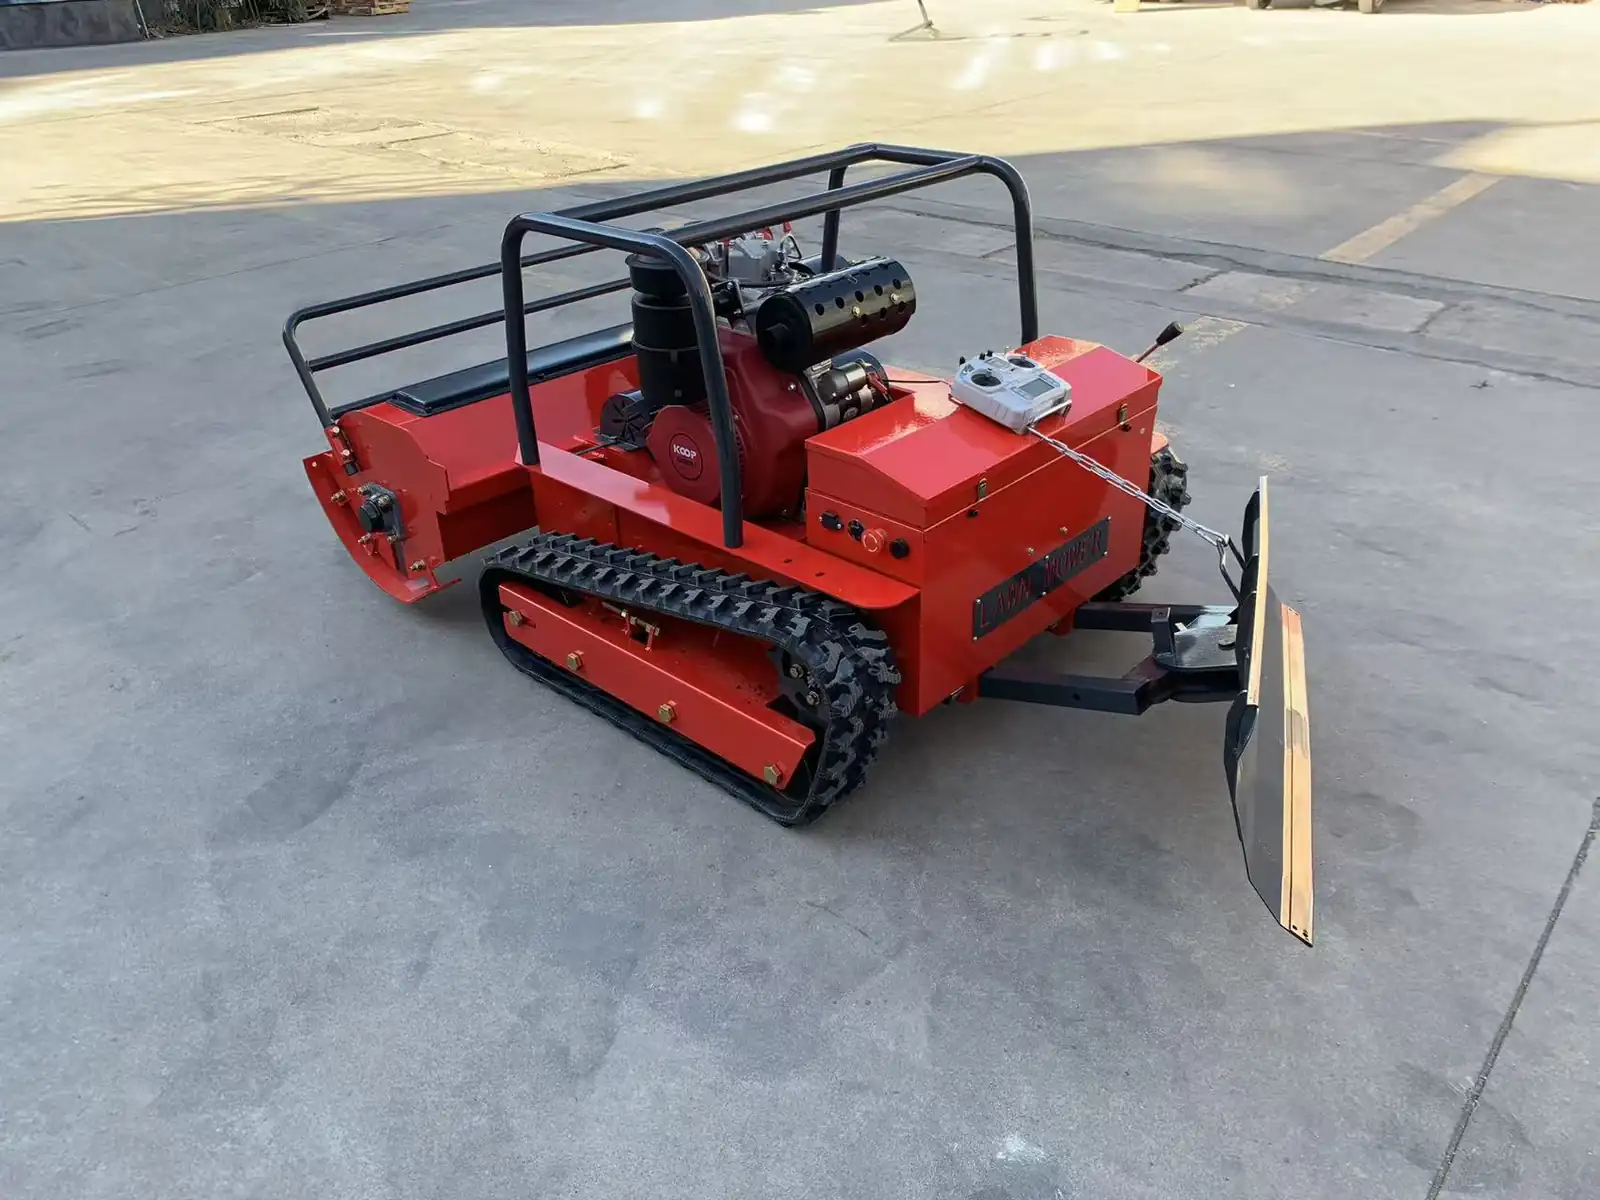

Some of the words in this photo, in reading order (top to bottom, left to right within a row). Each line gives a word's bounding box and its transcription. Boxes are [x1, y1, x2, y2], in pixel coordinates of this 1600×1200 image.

[673, 444, 697, 460] KOOP
[980, 574, 1033, 629] LAWN
[1044, 529, 1102, 587] MOWER
